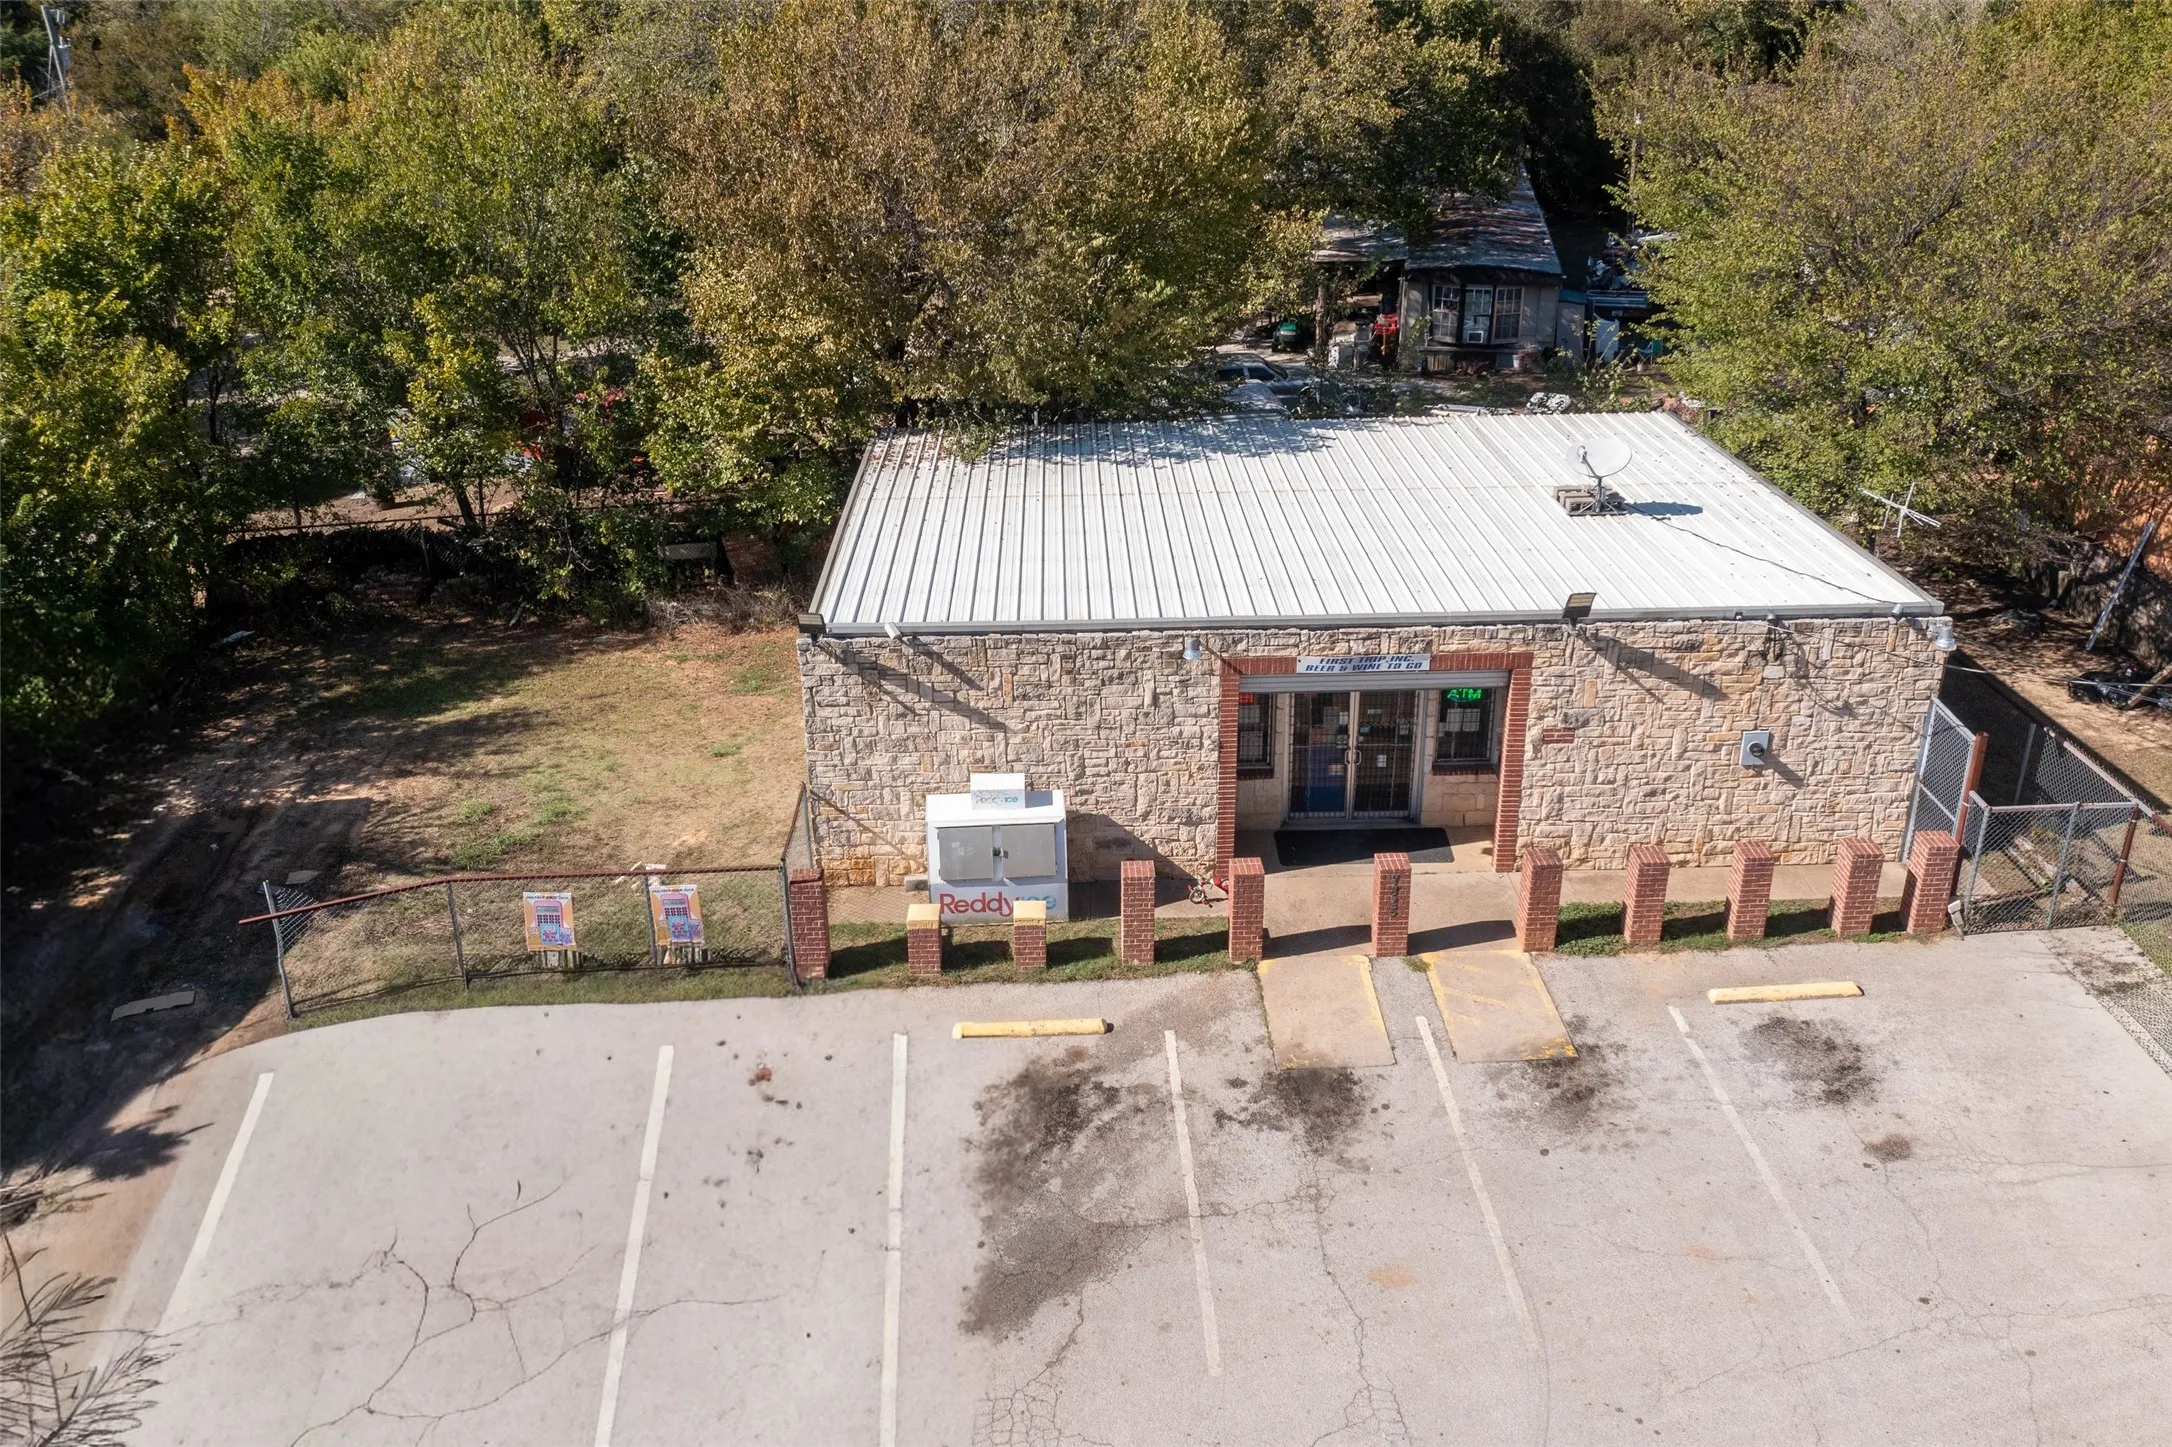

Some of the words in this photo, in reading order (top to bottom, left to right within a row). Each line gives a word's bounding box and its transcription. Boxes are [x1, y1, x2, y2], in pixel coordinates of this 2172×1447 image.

[1305, 664, 1336, 672] BEER
[1352, 663, 1382, 671] WINE
[1446, 688, 1482, 699] ATM
[940, 891, 1020, 917] Reddy
